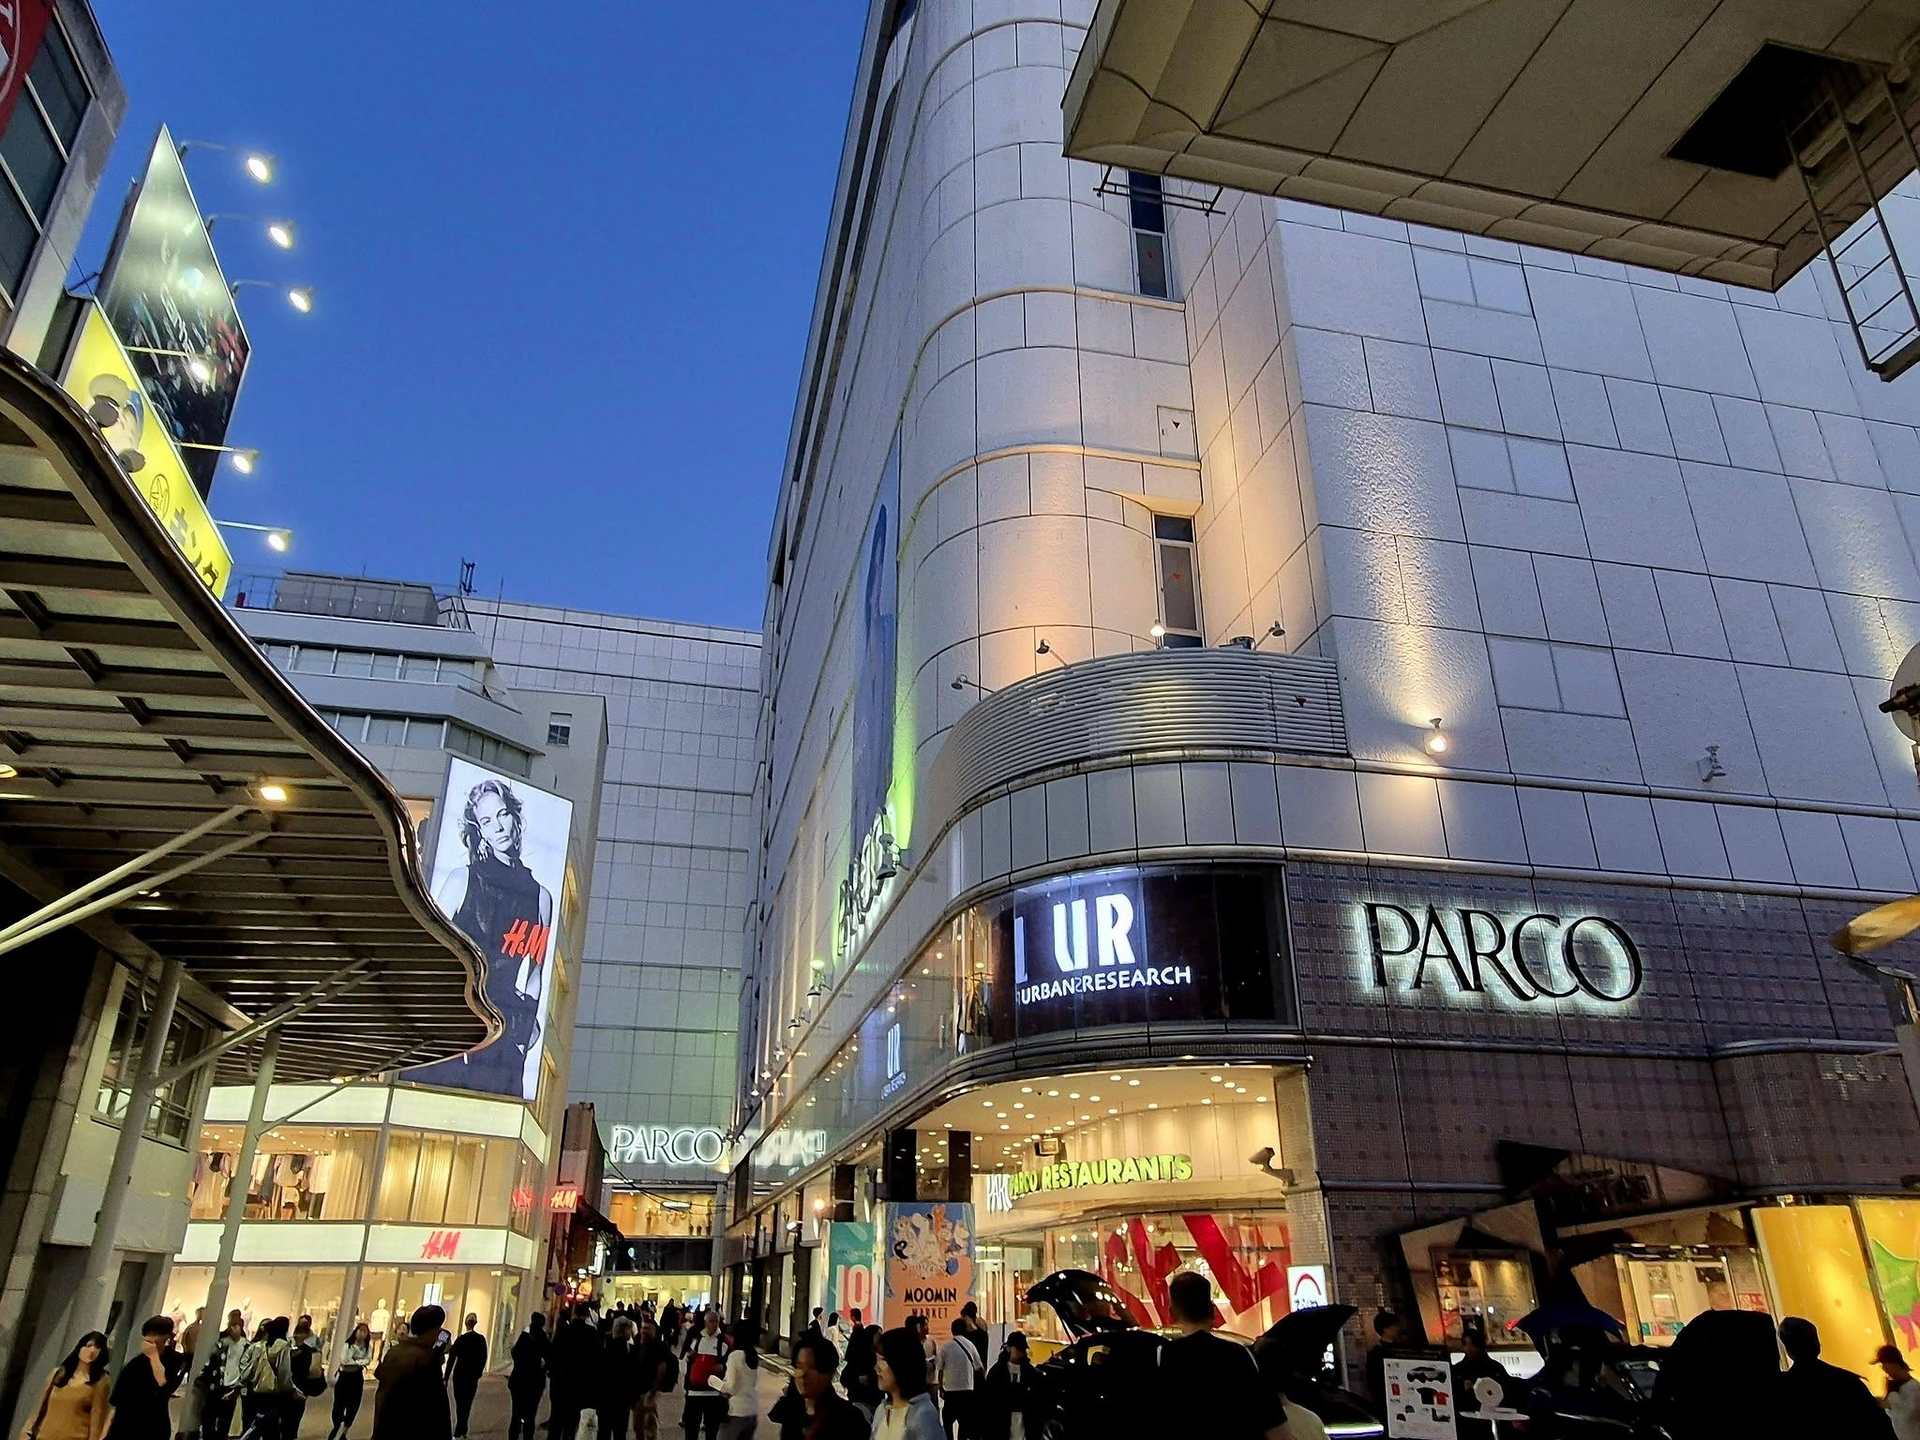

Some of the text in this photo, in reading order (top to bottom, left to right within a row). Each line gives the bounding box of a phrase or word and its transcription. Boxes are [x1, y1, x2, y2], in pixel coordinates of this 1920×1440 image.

[501, 918, 551, 966] H&M
[1053, 893, 1136, 972] UR
[1363, 901, 1642, 1001] PARCO
[1021, 965, 1192, 1005] URBAN RESEARCH
[612, 1127, 725, 1164] PARCO
[1041, 1154, 1193, 1192] RESTAURANTS
[904, 1287, 957, 1303] MOOMIN
[911, 1307, 948, 1319] MARKET
